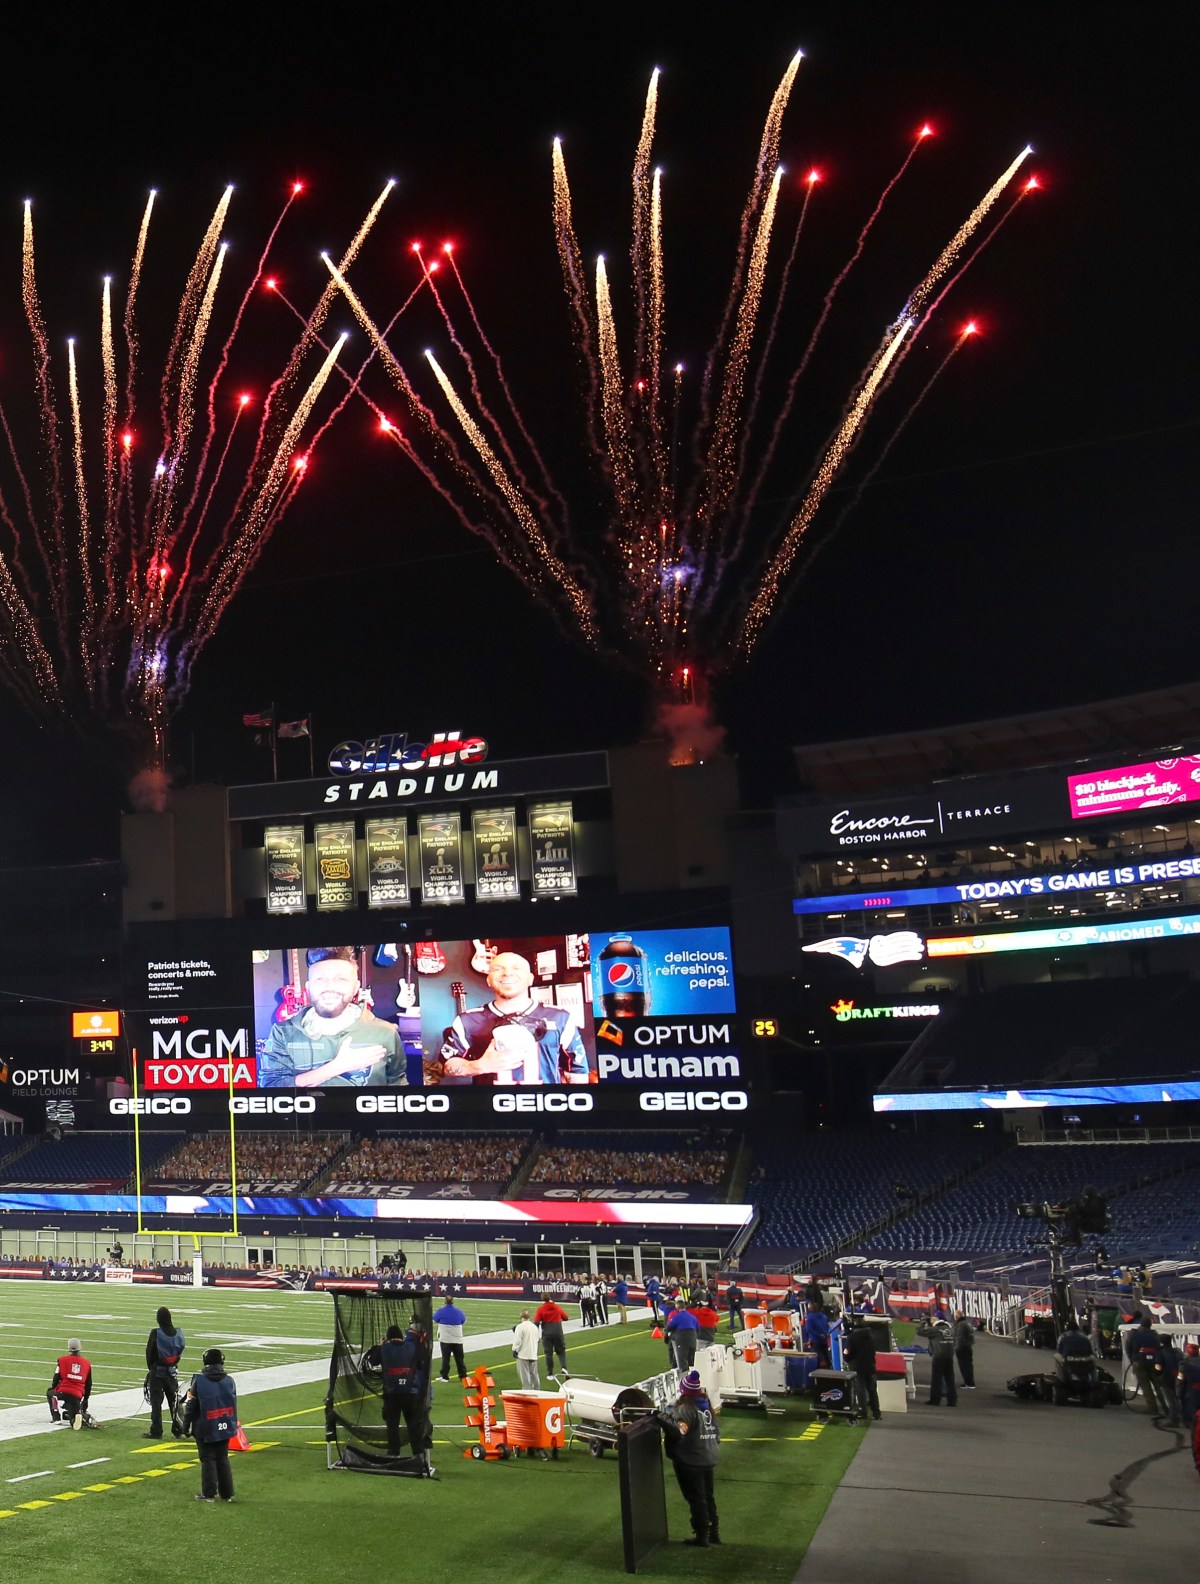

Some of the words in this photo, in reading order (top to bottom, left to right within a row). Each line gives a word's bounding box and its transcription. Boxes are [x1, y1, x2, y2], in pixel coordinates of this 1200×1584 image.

[329, 731, 489, 777] Gillette
[324, 770, 498, 803] STADIUM
[1075, 782, 1096, 795] $10
[1096, 772, 1156, 791] blackjack
[1077, 788, 1144, 807] minimums
[1145, 781, 1181, 796] daily.
[947, 805, 1011, 820] TERRACE
[829, 809, 934, 835] Encore
[839, 834, 881, 845] BOSTON
[884, 829, 927, 841] HARBOR
[481, 882, 513, 893] 2016
[538, 877, 571, 888] 2018
[956, 877, 1044, 900] TODAY'S
[1048, 869, 1111, 891] GAME
[1115, 866, 1135, 884] IS
[320, 893, 352, 903] 2003
[372, 890, 406, 900] 2004
[426, 887, 458, 897] 2014
[271, 897, 301, 906] 2001
[1099, 925, 1164, 943] ABIOMED
[664, 950, 728, 963] delicious.
[147, 961, 180, 970] Patriots
[180, 960, 210, 969] tickets,
[655, 963, 729, 976] refreshing.
[148, 970, 184, 979] concerts
[185, 969, 192, 978] &
[193, 969, 217, 977] more.
[636, 964, 644, 986] pepsi
[689, 976, 730, 990] pepsi.
[836, 1005, 940, 1022] DRAFTKINGS
[634, 1024, 730, 1046] OPTUM
[755, 1020, 776, 1036] 25
[90, 1039, 113, 1053] 3:49
[152, 1028, 246, 1060] MGM
[148, 1063, 253, 1085] TOYOTA
[597, 1053, 740, 1079] Putnam
[12, 1068, 80, 1086] OPTUM
[12, 1088, 38, 1097] FIELD
[39, 1087, 78, 1096] LOUNGE
[109, 1097, 191, 1115] GEICO
[228, 1095, 316, 1114] GEICO
[355, 1094, 449, 1113] GEICO
[492, 1092, 593, 1112] GEICO
[639, 1091, 748, 1111] GEICO
[324, 1184, 415, 1197] IOTS
[543, 1188, 690, 1199] Gllette
[106, 1271, 132, 1279] ESPN
[206, 1406, 234, 1420] ESPN
[482, 1396, 491, 1443] GATORADE
[545, 1406, 562, 1434] G
[218, 1422, 228, 1431] 20
